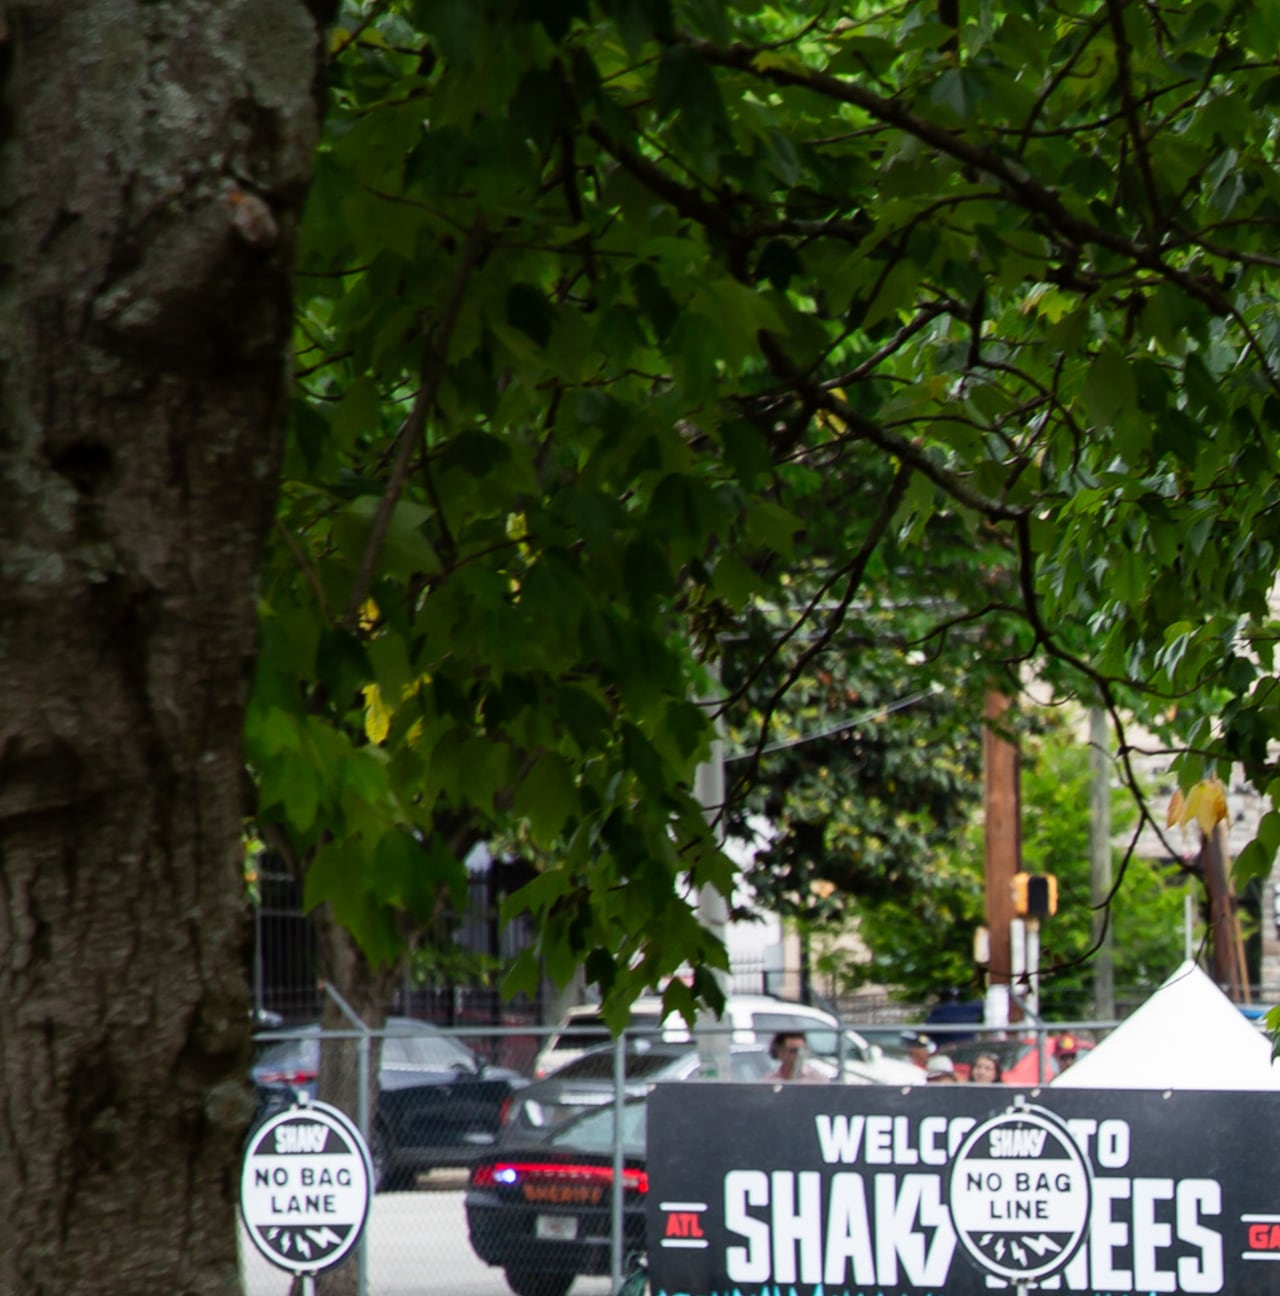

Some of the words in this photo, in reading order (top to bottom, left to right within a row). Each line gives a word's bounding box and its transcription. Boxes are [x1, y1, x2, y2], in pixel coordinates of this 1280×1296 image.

[989, 1128, 1048, 1157] SHAKY
[255, 1167, 288, 1187] NO
[300, 1167, 351, 1187] BAG
[967, 1172, 1002, 1192] NO
[1015, 1172, 1071, 1193] BAG
[271, 1194, 336, 1214] LANE
[990, 1200, 1049, 1220] LINE
[665, 1213, 704, 1237] ATL
